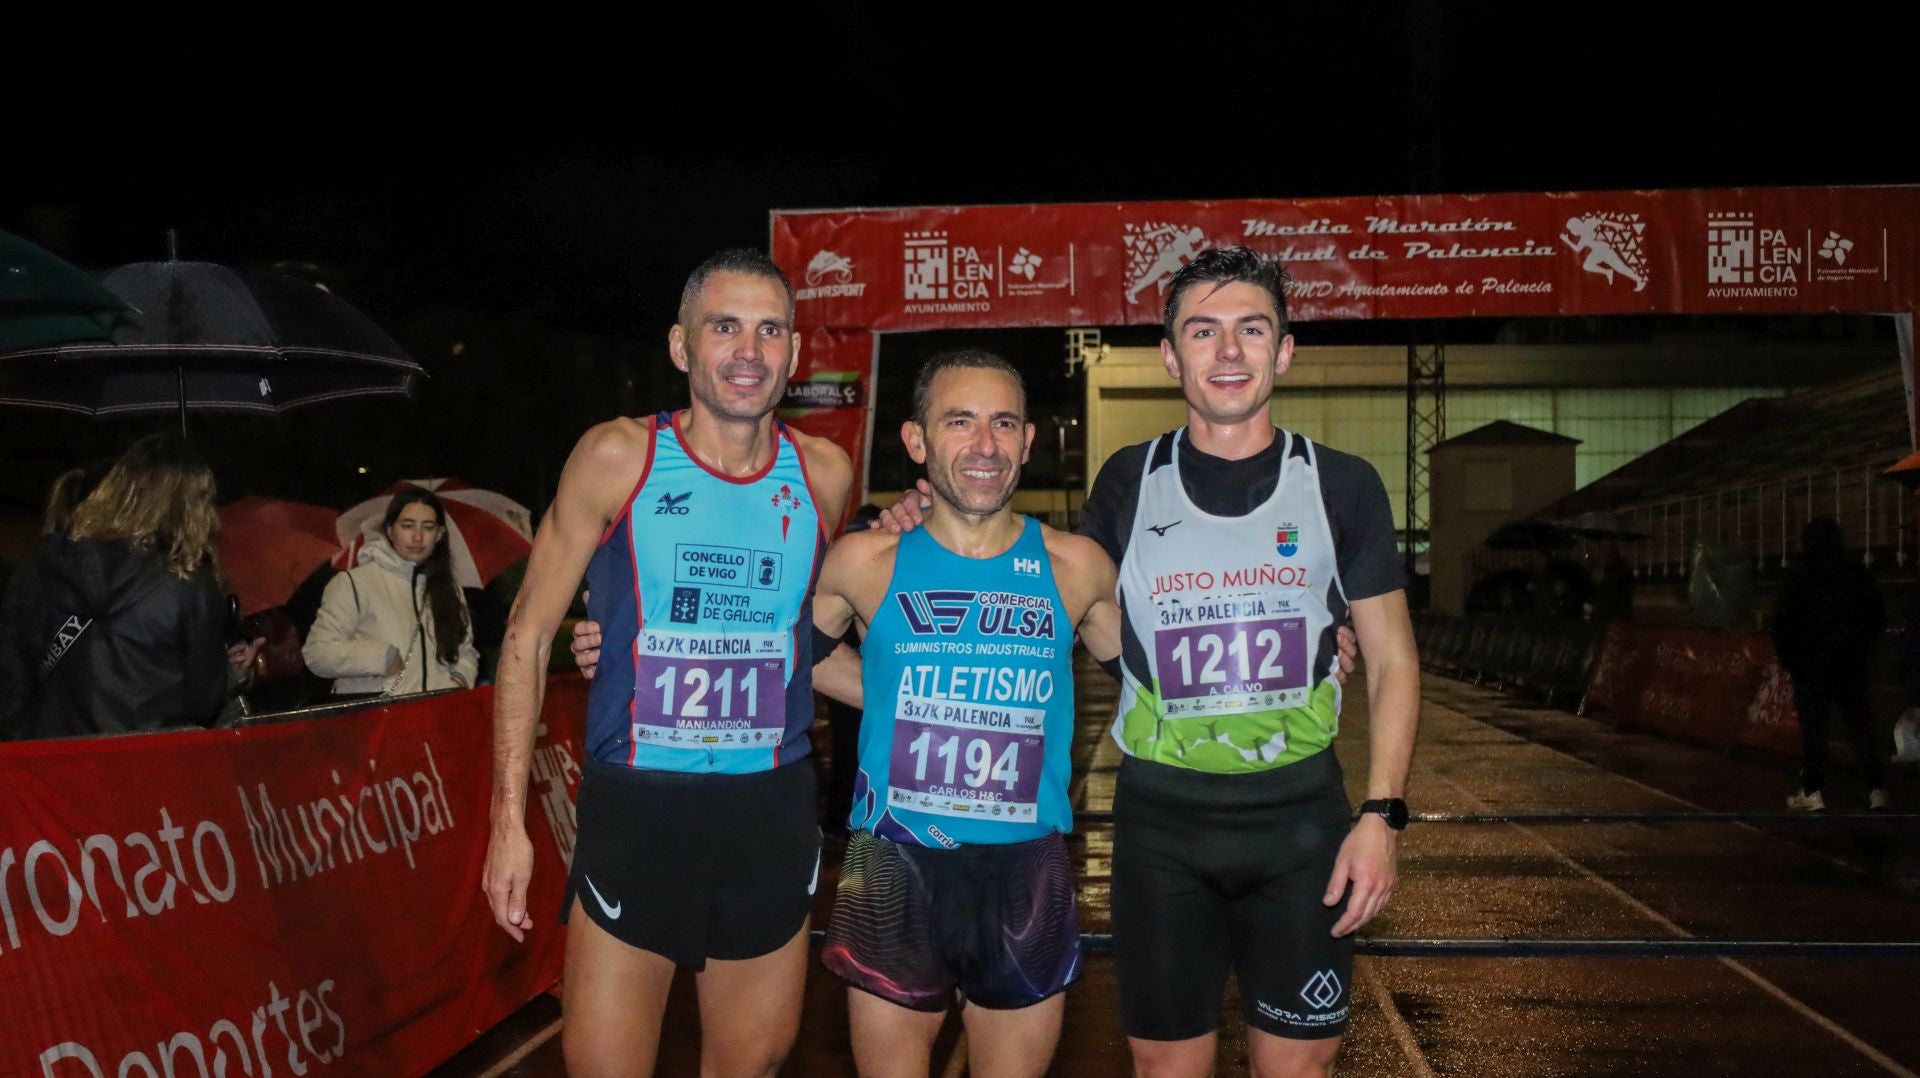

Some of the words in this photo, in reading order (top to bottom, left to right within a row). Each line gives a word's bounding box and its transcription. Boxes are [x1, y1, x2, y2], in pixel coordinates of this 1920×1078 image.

[1242, 219, 1352, 236] Media
[1365, 216, 1517, 234] Maratón
[1759, 229, 1787, 246] PA
[953, 246, 980, 263] PA
[1261, 245, 1336, 261] udad
[1348, 245, 1388, 260] de
[1404, 239, 1557, 260] Palencia
[1759, 247, 1802, 265] LEN
[953, 264, 994, 281] LEN
[1758, 265, 1797, 284] CIA
[952, 282, 990, 299] CIA
[1337, 280, 1449, 300] Ayuntamiento
[1455, 281, 1474, 295] de
[1481, 278, 1553, 295] Palencia
[1706, 286, 1798, 298] AYUNTAMIENTO
[904, 301, 991, 314] AYUNTAMIENTO
[787, 385, 843, 398] LABORAL
[654, 506, 690, 515] ZICO
[682, 551, 745, 567] CONCELLO
[688, 566, 706, 578] DE
[708, 567, 737, 580] VIGO
[1151, 572, 1215, 596] JUSTO
[1222, 563, 1308, 588] MUÑOZ
[705, 592, 751, 608] XUNTA
[978, 591, 1053, 611] COMERCIAL
[703, 606, 721, 621] DE
[722, 608, 776, 624] GALICIA
[1198, 600, 1267, 621] PALENCIA
[977, 606, 1056, 640] ULSA
[689, 638, 752, 655] PALENCIA
[894, 642, 973, 656] SUMINISTROS
[975, 643, 1056, 660] INDUSTRIALES
[1172, 629, 1284, 686] 1212
[654, 666, 759, 719] 1211
[897, 665, 1055, 703] ATLETISMO
[1223, 682, 1263, 695] CALVO
[943, 706, 1012, 728] PALENCIA
[908, 732, 1019, 791] 1194
[929, 785, 977, 799] CARLOS
[979, 791, 1004, 802] H&C
[0, 806, 237, 956] ronato
[237, 741, 455, 889] Municipal
[1257, 999, 1302, 1021] VALORA
[39, 979, 346, 1078] ortes
